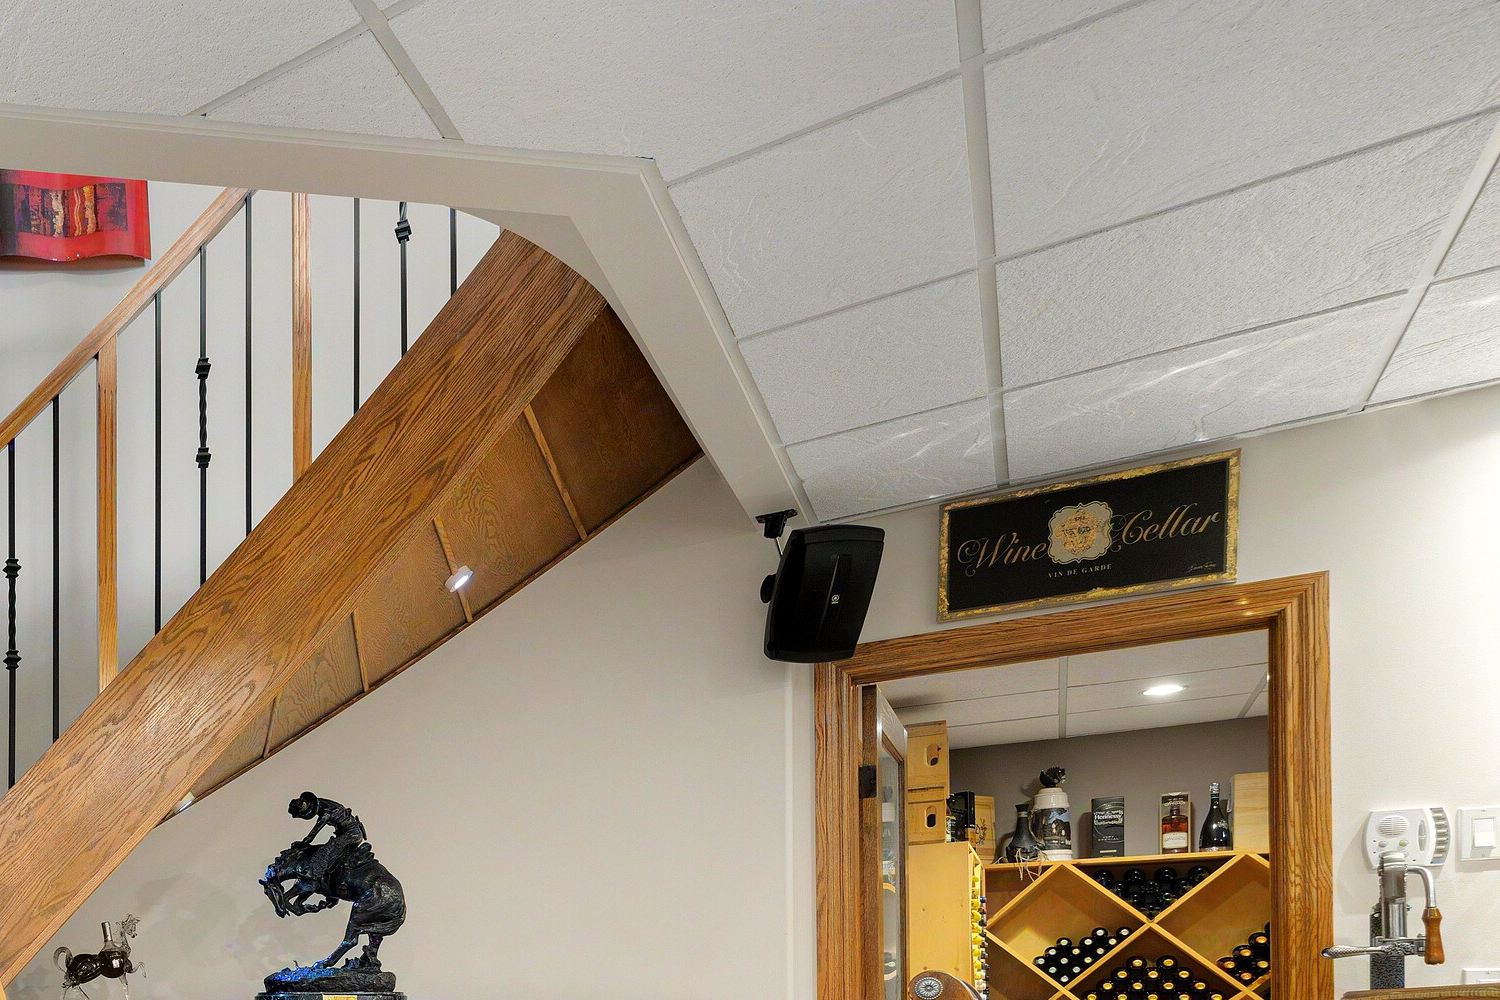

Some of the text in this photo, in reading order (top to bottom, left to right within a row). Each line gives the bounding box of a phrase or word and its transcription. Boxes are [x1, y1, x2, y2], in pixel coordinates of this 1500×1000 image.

[957, 502, 1221, 577] Wine Cellar
[1081, 563, 1112, 574] GARDE
